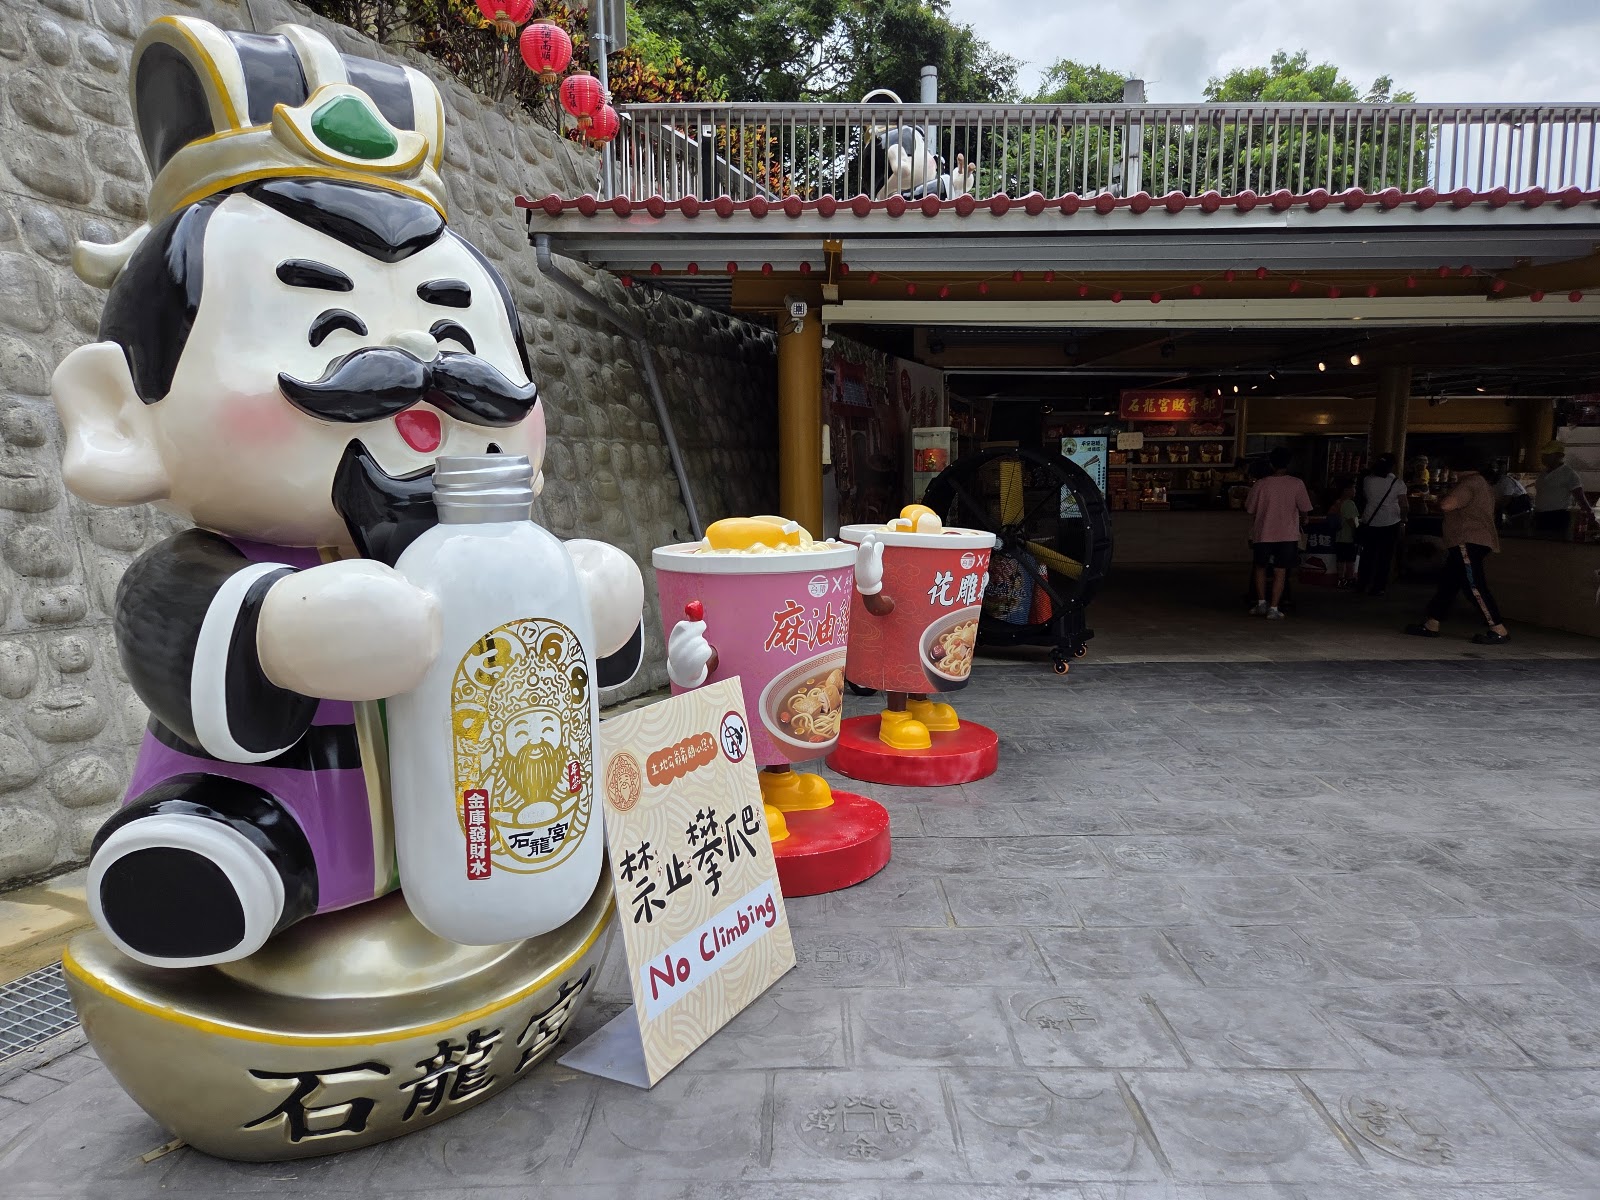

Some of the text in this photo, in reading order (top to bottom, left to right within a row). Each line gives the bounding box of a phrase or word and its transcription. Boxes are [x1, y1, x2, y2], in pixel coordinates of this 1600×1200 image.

[1128, 397, 1216, 413] 石龍宮販賣部
[466, 792, 489, 876] 金庫發財水
[508, 823, 569, 858] 石龍宮
[619, 804, 760, 924] 禁止攀爬
[648, 953, 691, 1001] No
[698, 893, 777, 963] Climbing
[243, 965, 592, 1143] 石龍宮
